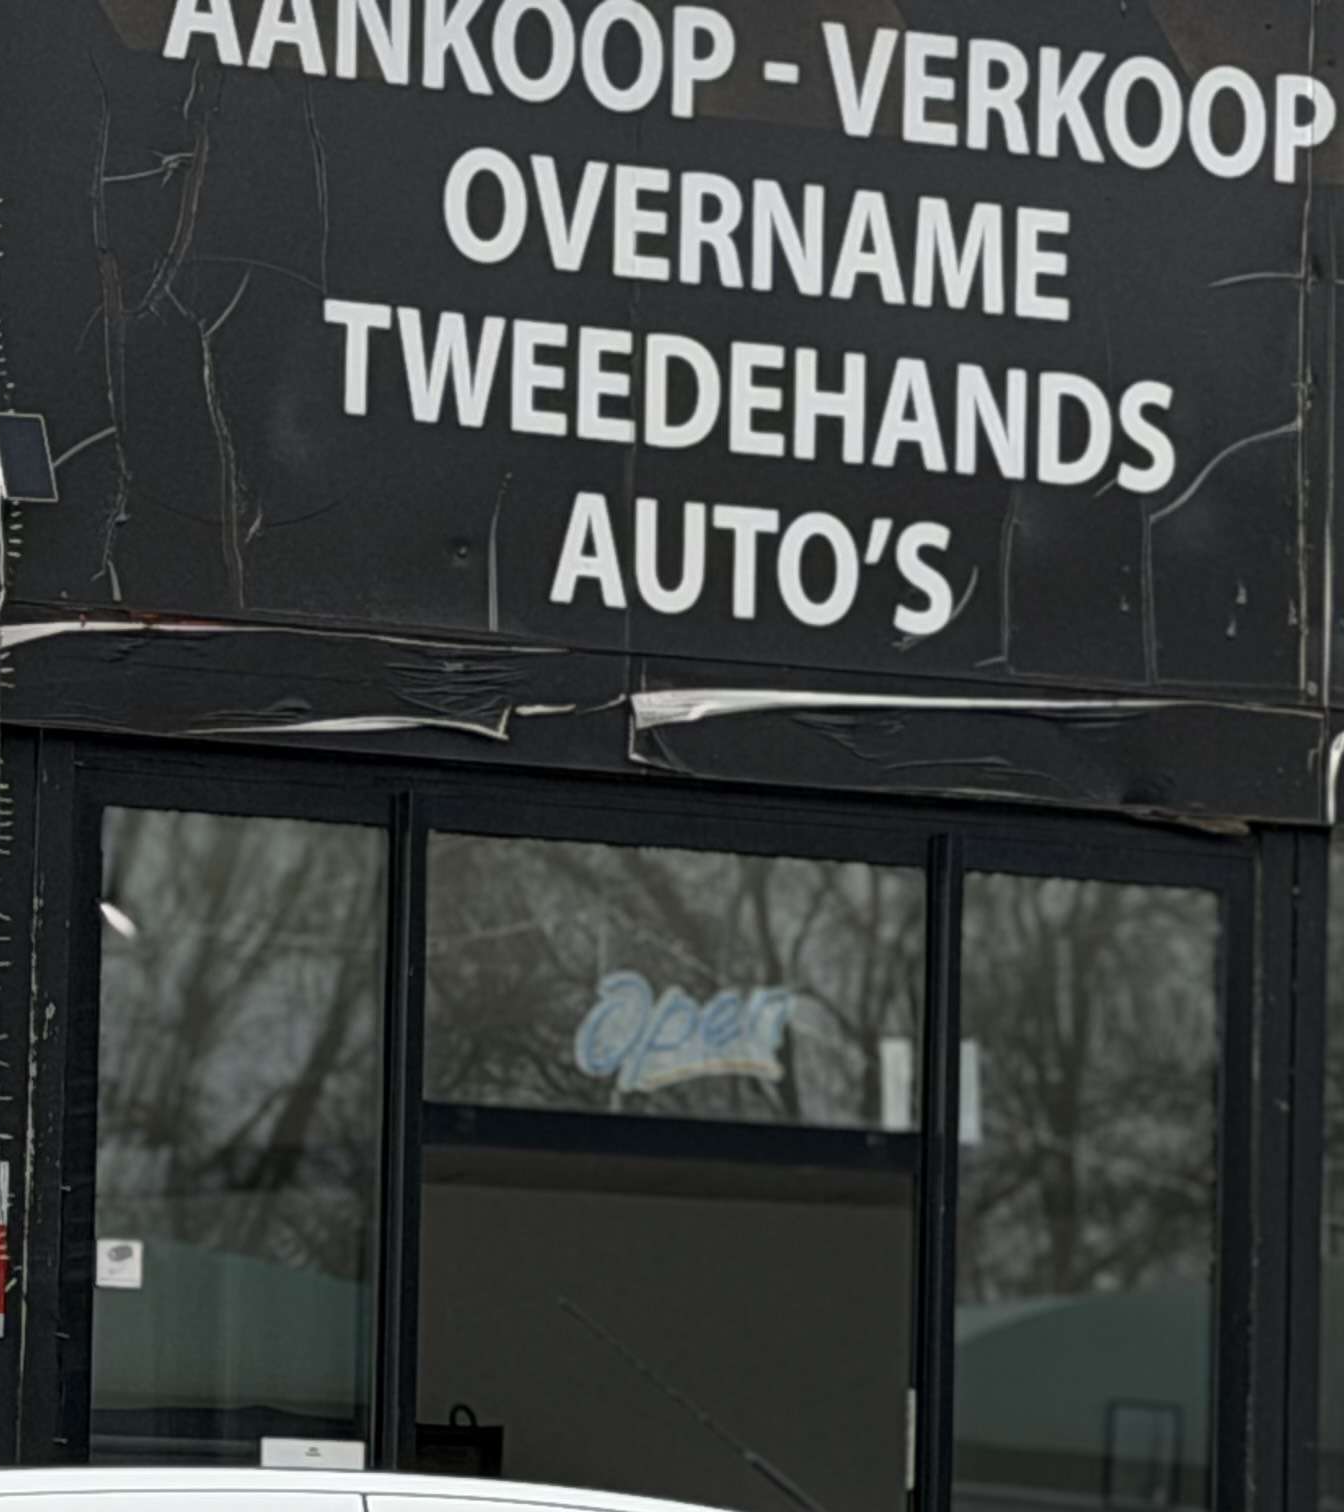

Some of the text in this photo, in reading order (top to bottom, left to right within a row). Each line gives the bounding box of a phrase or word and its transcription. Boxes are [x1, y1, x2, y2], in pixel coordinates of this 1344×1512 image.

[162, 0, 734, 118] AANKOOP
[824, 22, 1337, 184] VERKOOP
[443, 147, 1071, 321] OVERNAME
[323, 299, 1176, 494] TWEEDEHANDS
[551, 492, 953, 636] AUTO'S
